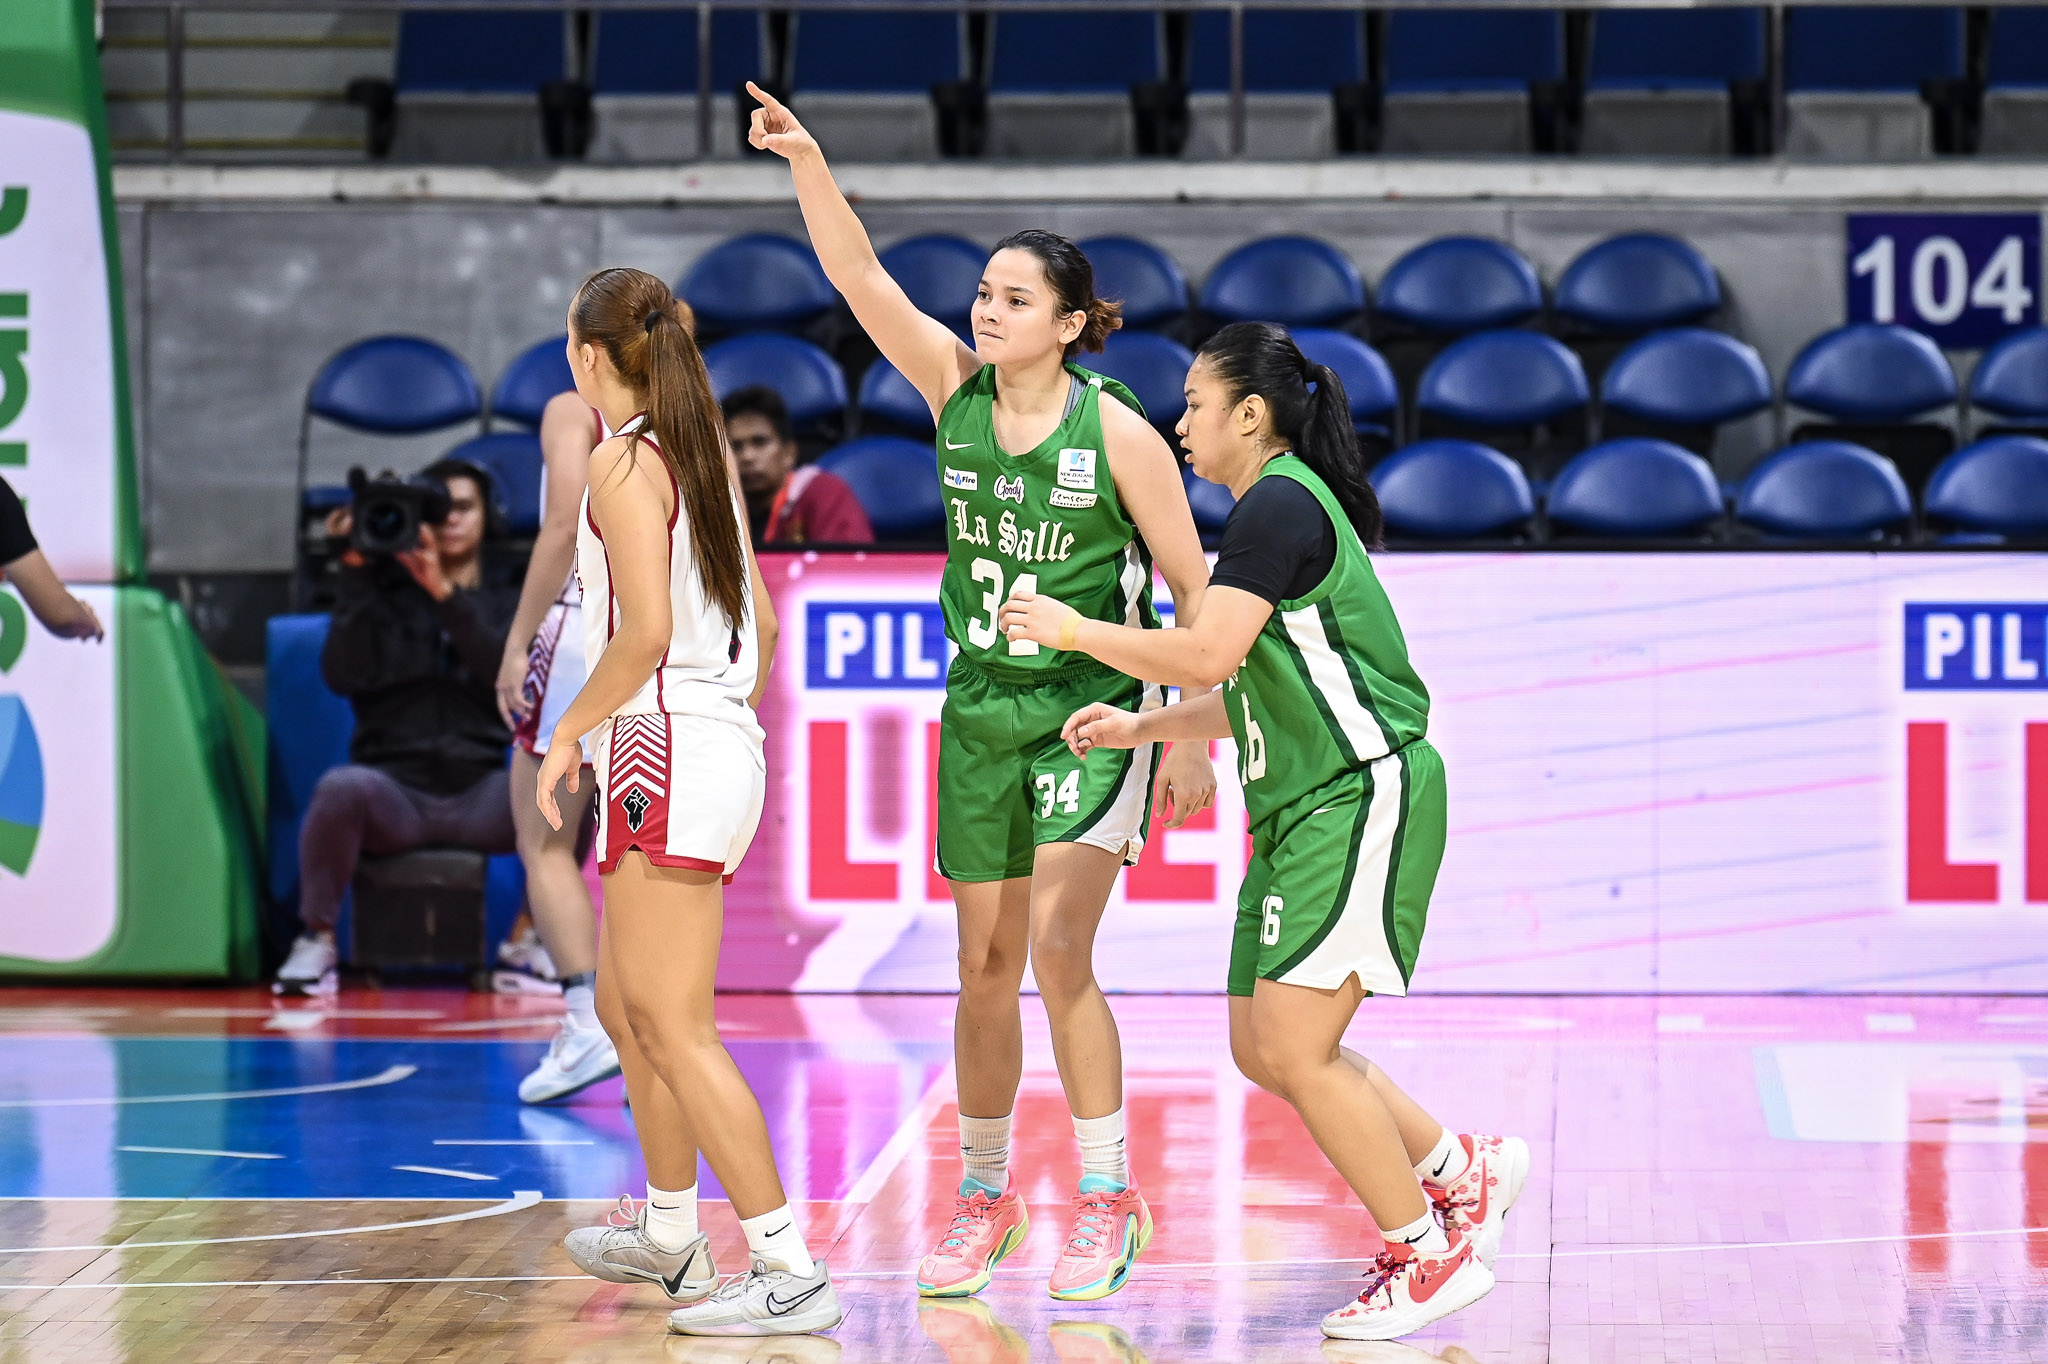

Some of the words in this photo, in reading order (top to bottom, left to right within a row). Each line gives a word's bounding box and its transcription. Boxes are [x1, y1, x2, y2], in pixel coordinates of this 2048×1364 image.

[1854, 234, 2033, 325] 104
[962, 475, 976, 484] Fire
[996, 477, 1022, 501] Goody
[951, 498, 991, 547] La
[998, 509, 1075, 563] Salle
[824, 613, 942, 680] PIL
[1923, 613, 2048, 680] PIL
[1035, 769, 1081, 819] 34
